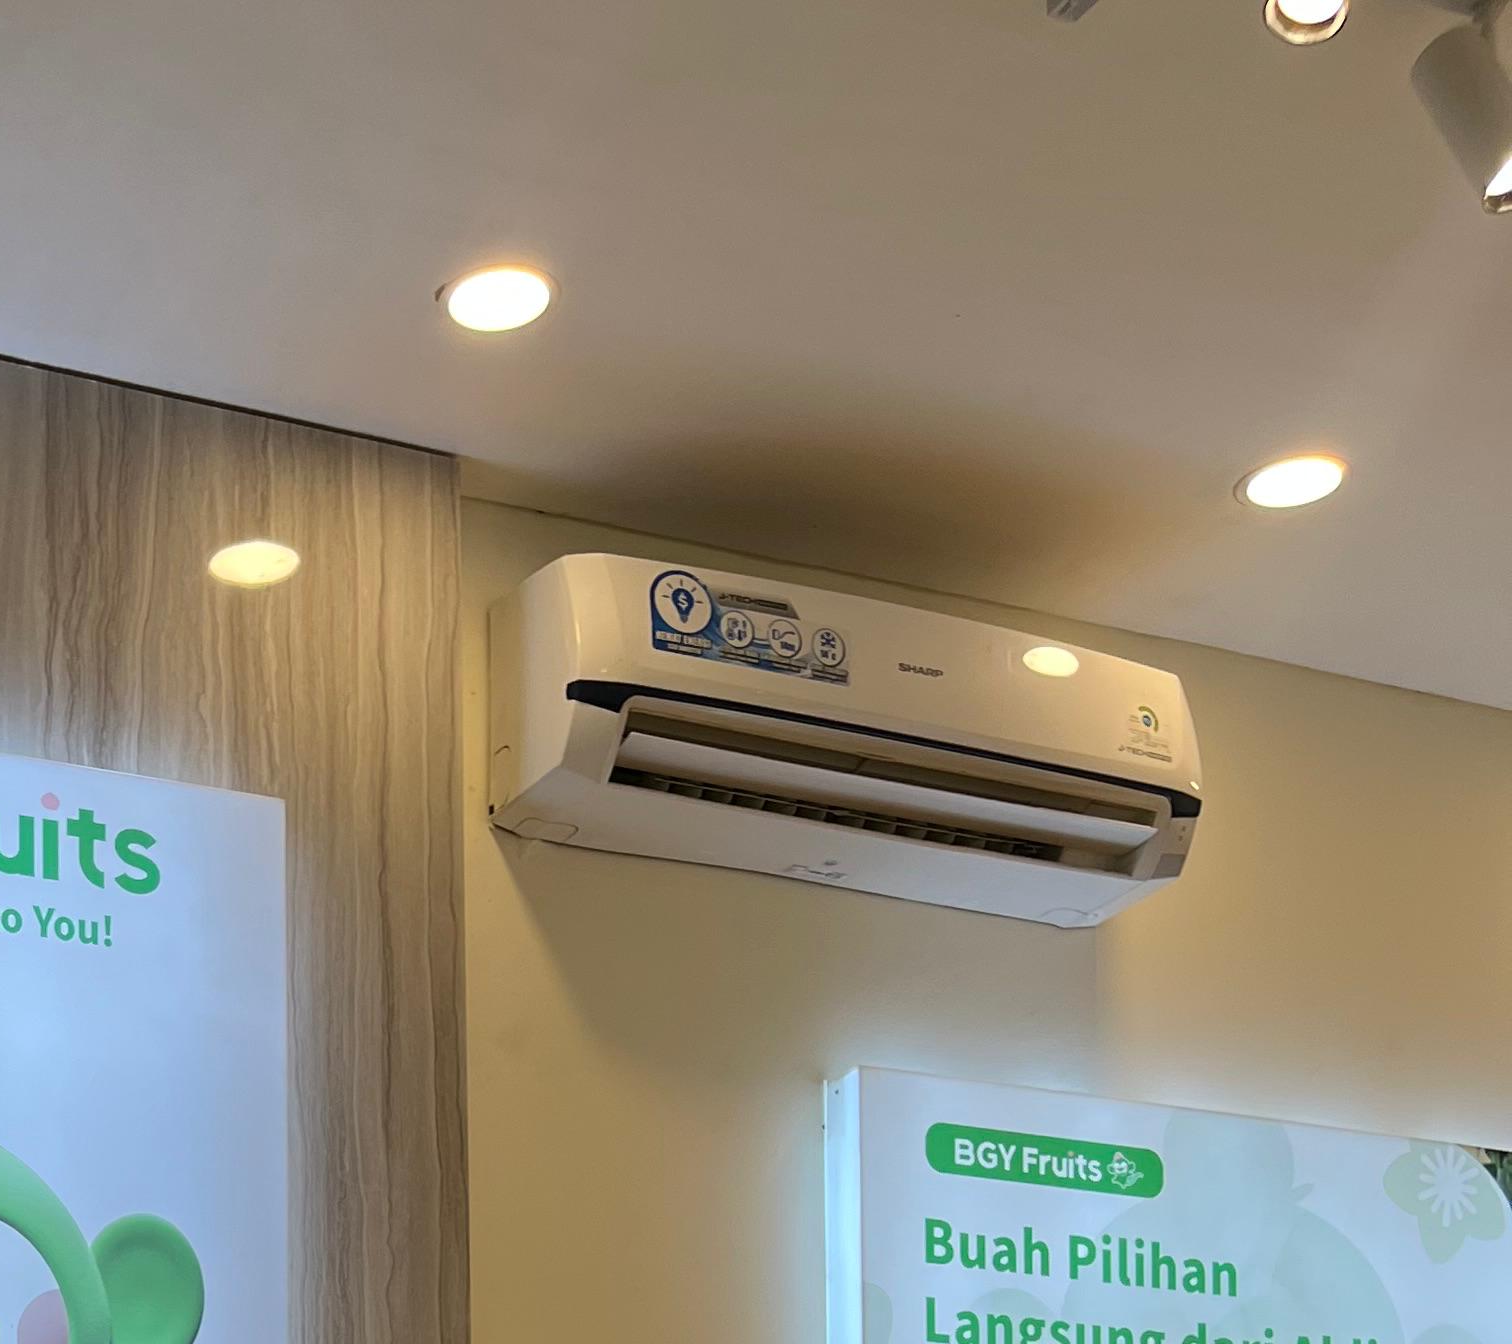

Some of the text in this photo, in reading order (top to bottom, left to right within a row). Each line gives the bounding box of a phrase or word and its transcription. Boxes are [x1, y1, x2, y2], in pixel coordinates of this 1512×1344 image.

[897, 662, 944, 677] SHARP
[32, 904, 114, 949] You!
[954, 1137, 1103, 1183] BGY Fruits
[924, 1216, 1239, 1297] Buah Pilihan
